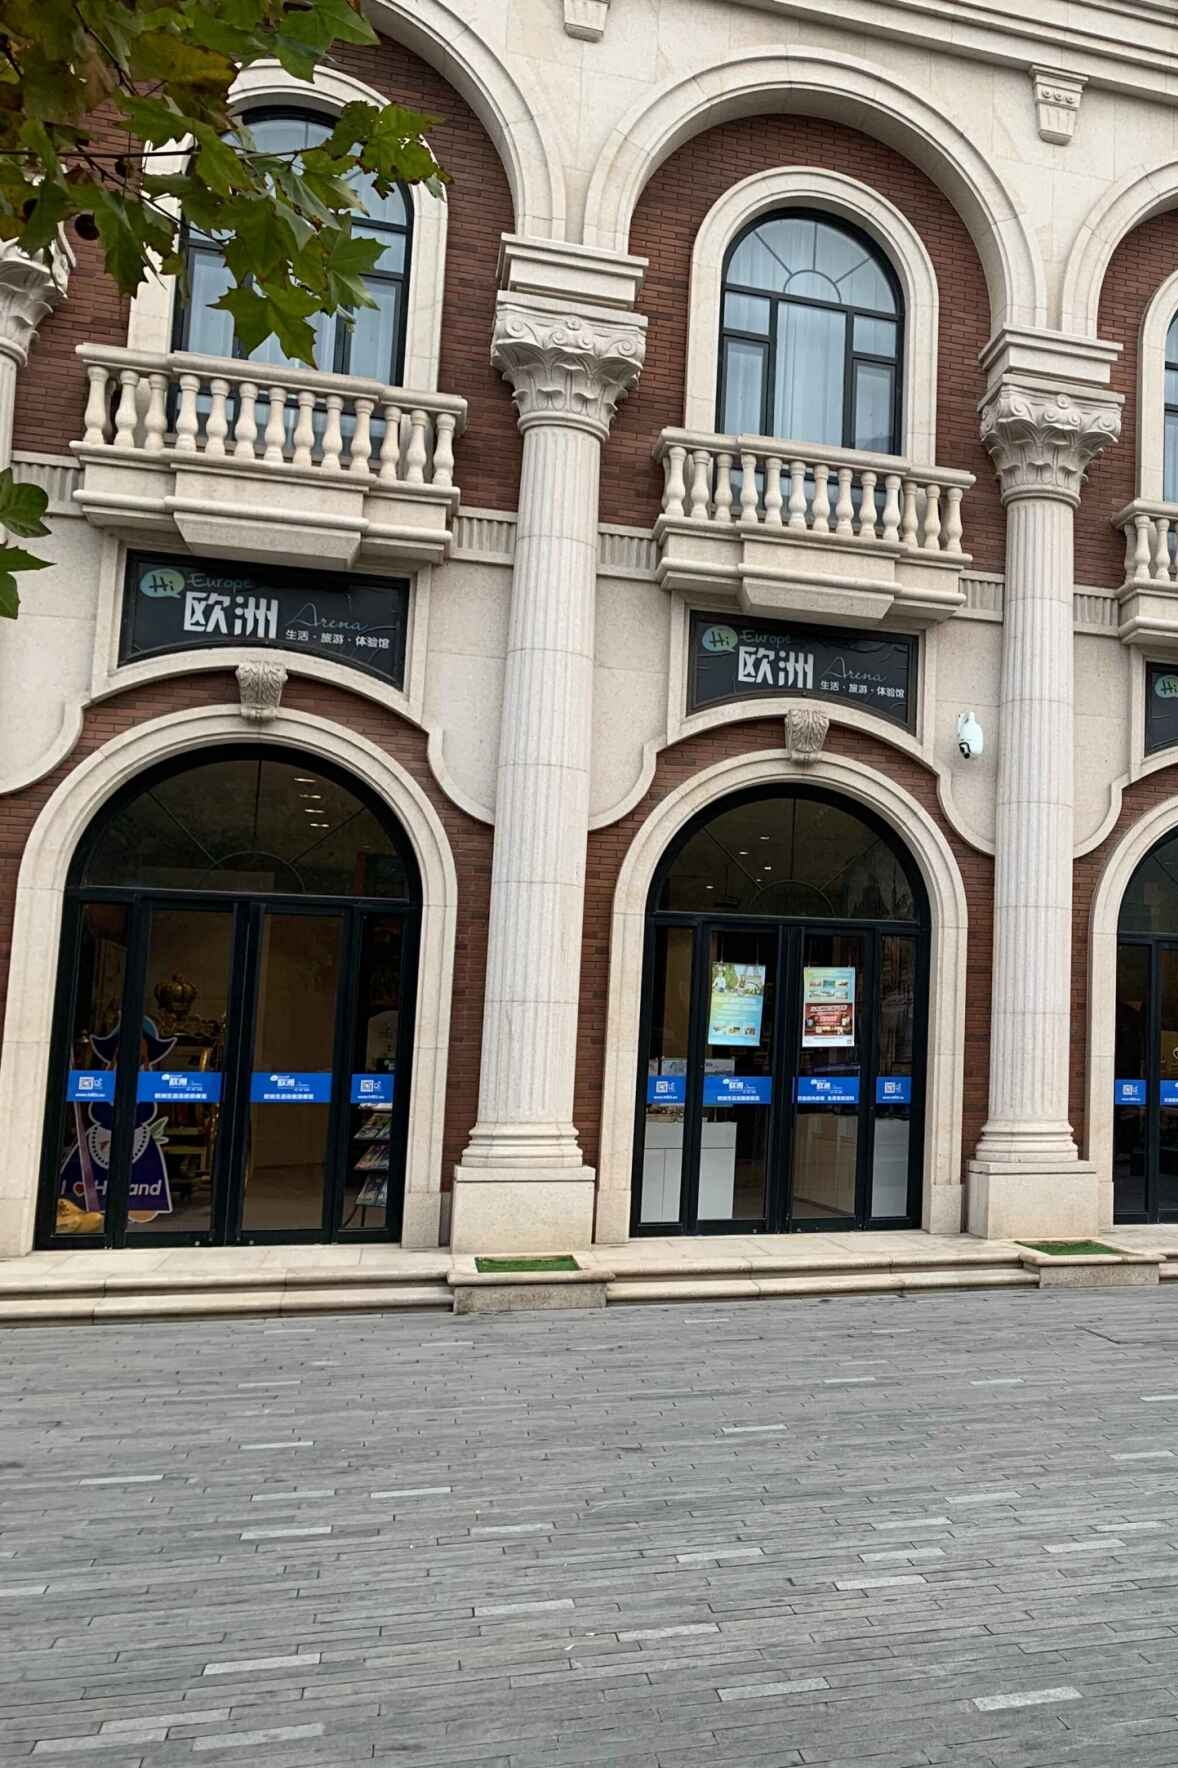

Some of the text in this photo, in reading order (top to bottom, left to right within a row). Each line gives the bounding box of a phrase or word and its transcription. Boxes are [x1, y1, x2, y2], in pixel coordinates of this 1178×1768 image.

[149, 573, 254, 593] Hi Europe
[183, 591, 279, 639] 欧洲
[286, 602, 372, 631] Arena
[708, 630, 792, 649] Hi Europe
[738, 645, 814, 689] 欧洲
